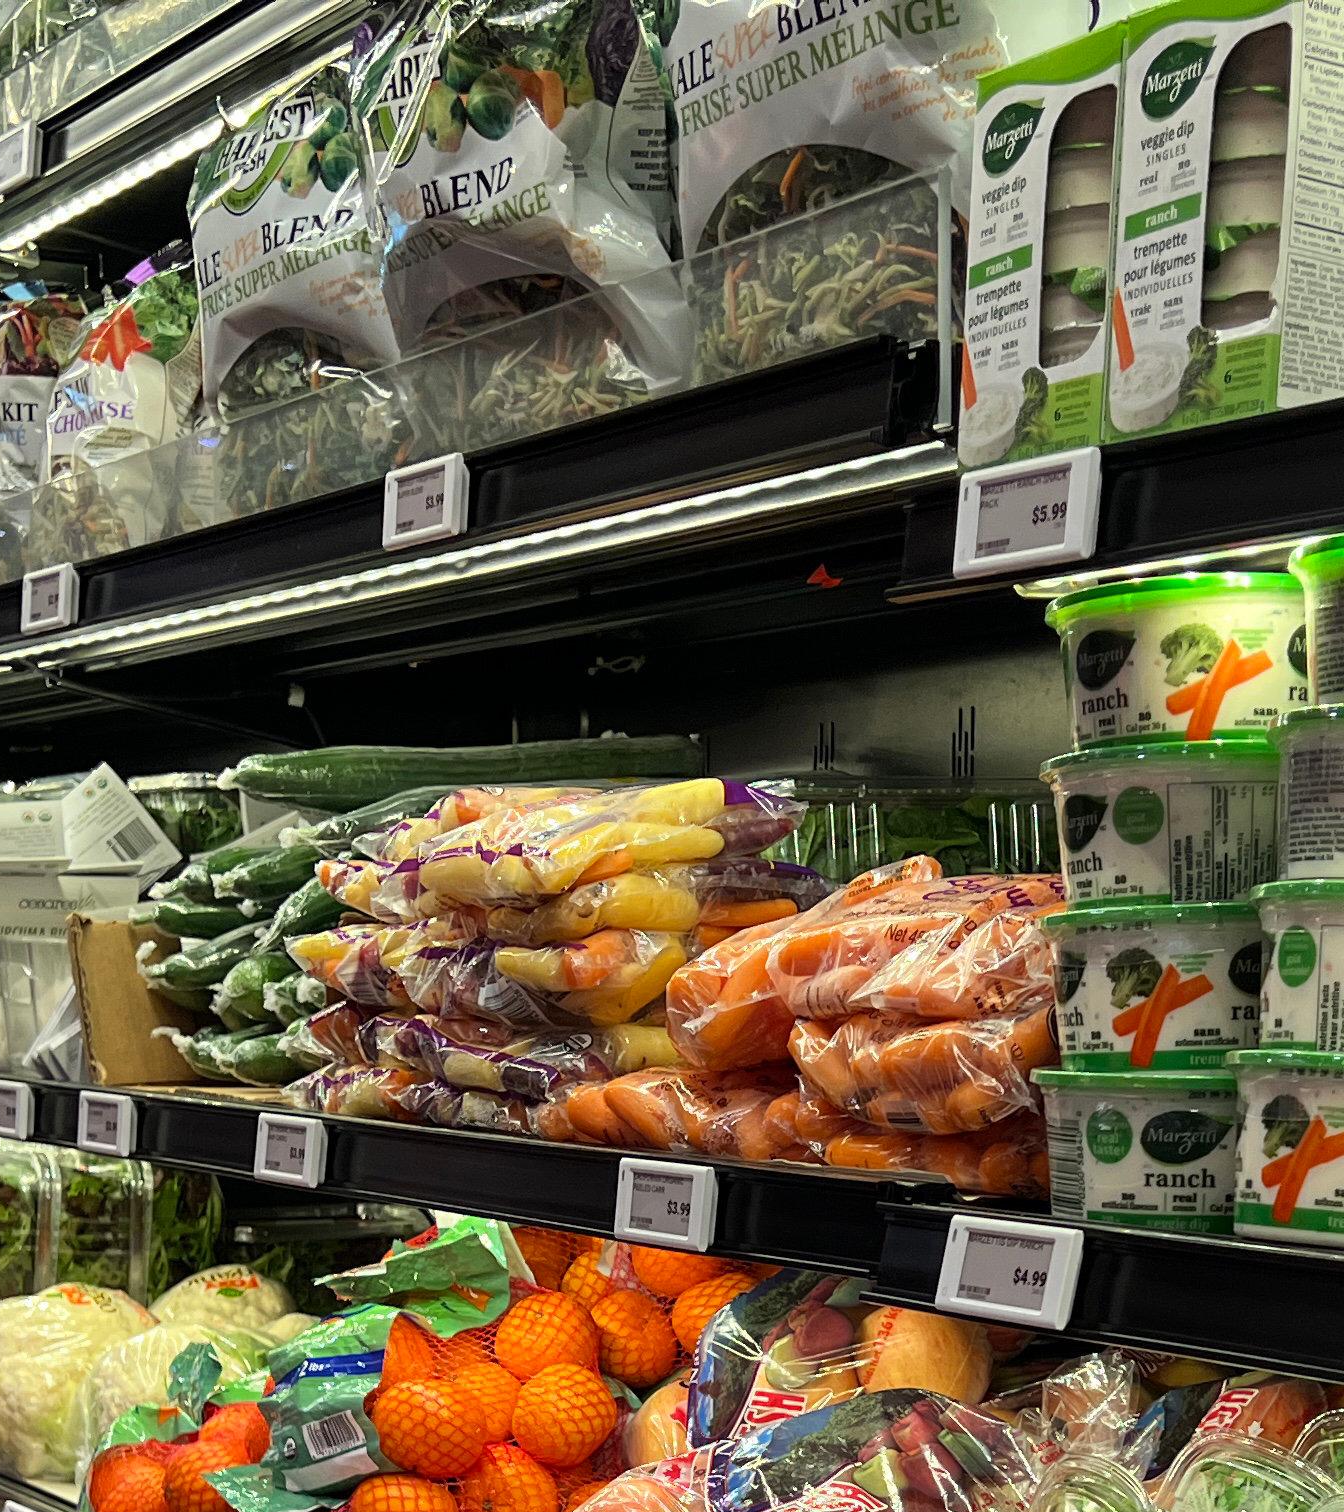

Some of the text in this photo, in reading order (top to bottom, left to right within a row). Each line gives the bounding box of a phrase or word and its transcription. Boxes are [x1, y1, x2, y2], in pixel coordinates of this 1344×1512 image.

[715, 10, 777, 71] SUPER
[679, 2, 959, 136] FRISÉ SUPER MÉLANGE
[1144, 57, 1204, 103] Marzetti
[984, 117, 1035, 161] Marzetti
[1140, 119, 1195, 152] veggie dip
[1145, 143, 1187, 168] SINGLES
[1178, 158, 1191, 172] no
[420, 157, 513, 220] BLEND
[981, 175, 1027, 206] veggie dip
[1139, 171, 1159, 188] real
[986, 198, 1021, 222] SINGLES
[1144, 205, 1178, 229] ranch
[1133, 232, 1188, 260] trempette
[985, 253, 1013, 279] ranch
[1124, 250, 1197, 288] pour légumes
[234, 260, 281, 305] SUPER
[976, 278, 1022, 306] trempette
[1124, 272, 1194, 302] INDIVIDUELLES
[967, 296, 1030, 331] pour légumes
[5, 402, 39, 422] KIT
[1032, 502, 1067, 526] $5.99
[1078, 648, 1125, 676] Marzetti
[1081, 688, 1129, 716] ranch
[1253, 707, 1278, 717] sans
[1098, 717, 1115, 728] real
[884, 924, 908, 942] Net
[1146, 1127, 1218, 1155] Marzetti
[1144, 1168, 1217, 1189] ranch
[667, 1200, 691, 1217] $3.99
[1173, 1194, 1198, 1203] real
[1013, 1266, 1047, 1288] $4.99
[299, 1360, 309, 1378] 2
